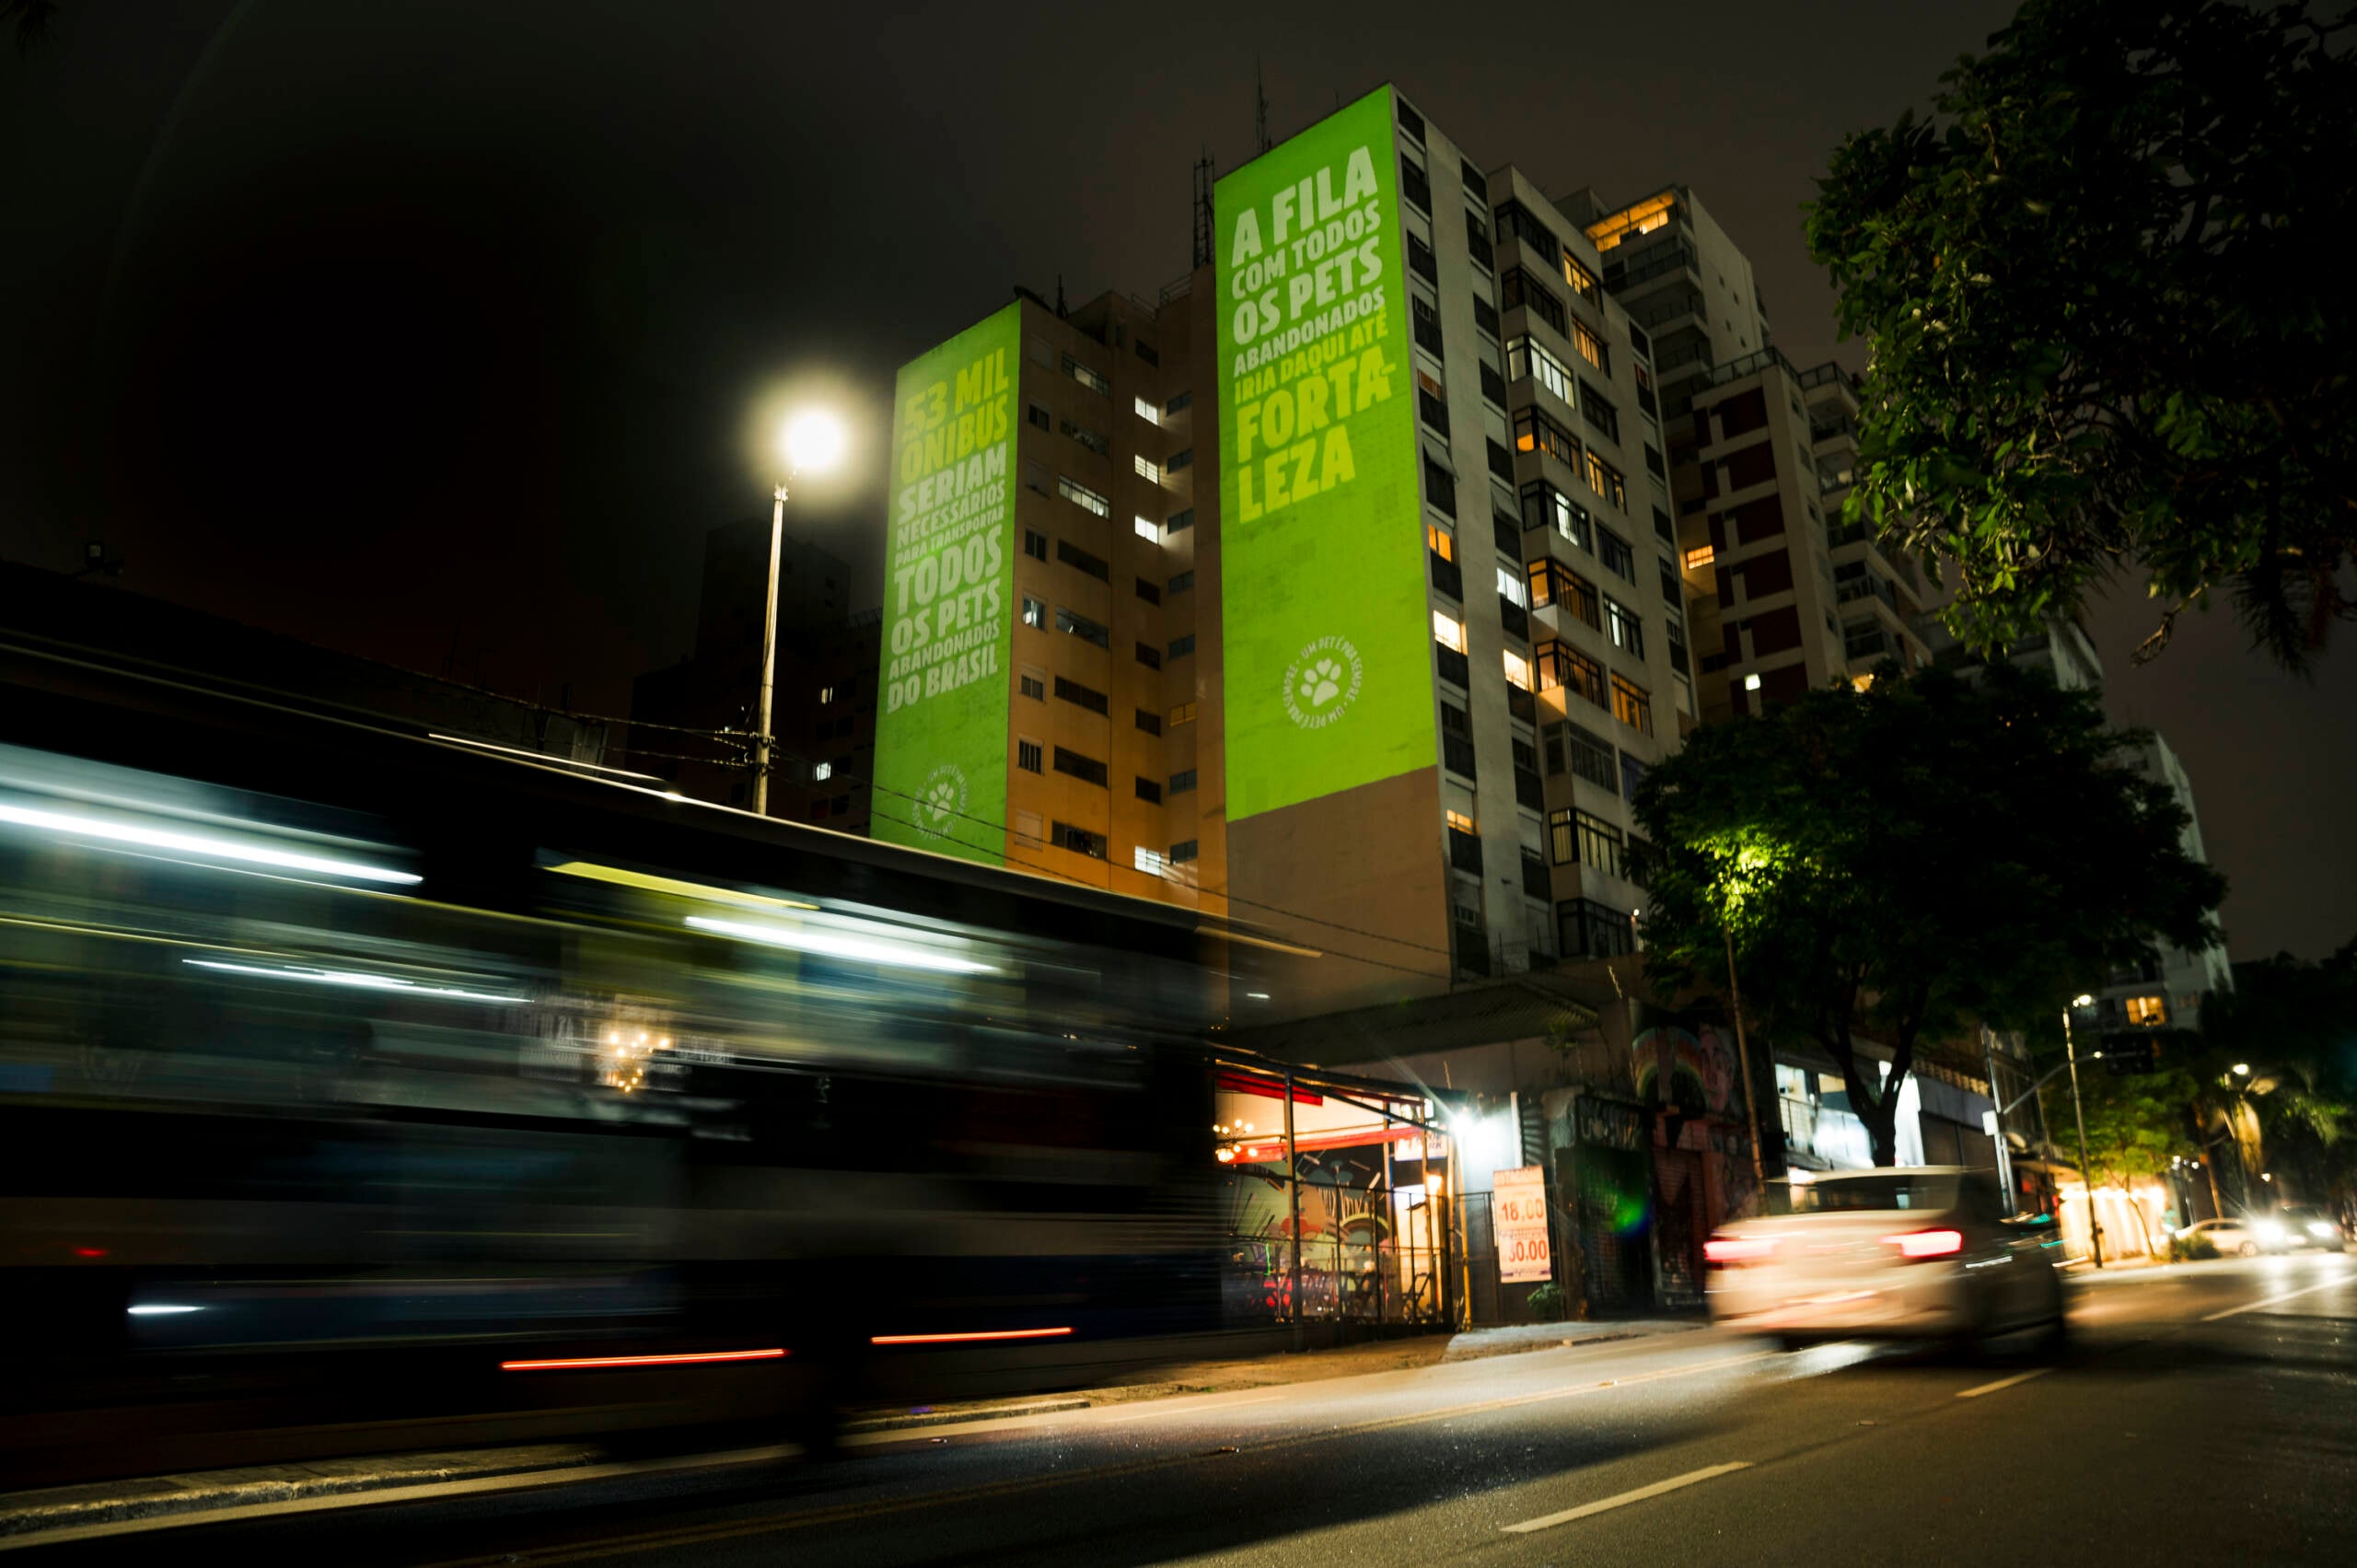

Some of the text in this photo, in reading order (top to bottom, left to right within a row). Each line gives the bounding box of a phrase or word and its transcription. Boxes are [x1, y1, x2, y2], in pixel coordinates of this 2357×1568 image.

[1232, 145, 1378, 269] A FILA
[1232, 199, 1380, 300] COM TODOS
[1234, 236, 1382, 345] OS PETS
[1234, 285, 1385, 377] ABANDONADOS
[904, 347, 1009, 432] 53 MIL
[1235, 304, 1388, 405] IRIA DAQUI ATÉ
[901, 394, 1007, 483] ÔNIBUS
[1237, 345, 1397, 464] FORTA-
[897, 480, 1004, 550] NECESSÁRIOS
[898, 442, 1006, 526] SERIAM
[1238, 424, 1355, 524] LEZA
[894, 525, 1002, 616] TODOS
[895, 505, 1004, 568] PARA TRANSPORTAR
[888, 618, 999, 681] ABANDONADOS
[891, 577, 1001, 656] OS PETS
[887, 643, 998, 724] DO BRASIL
